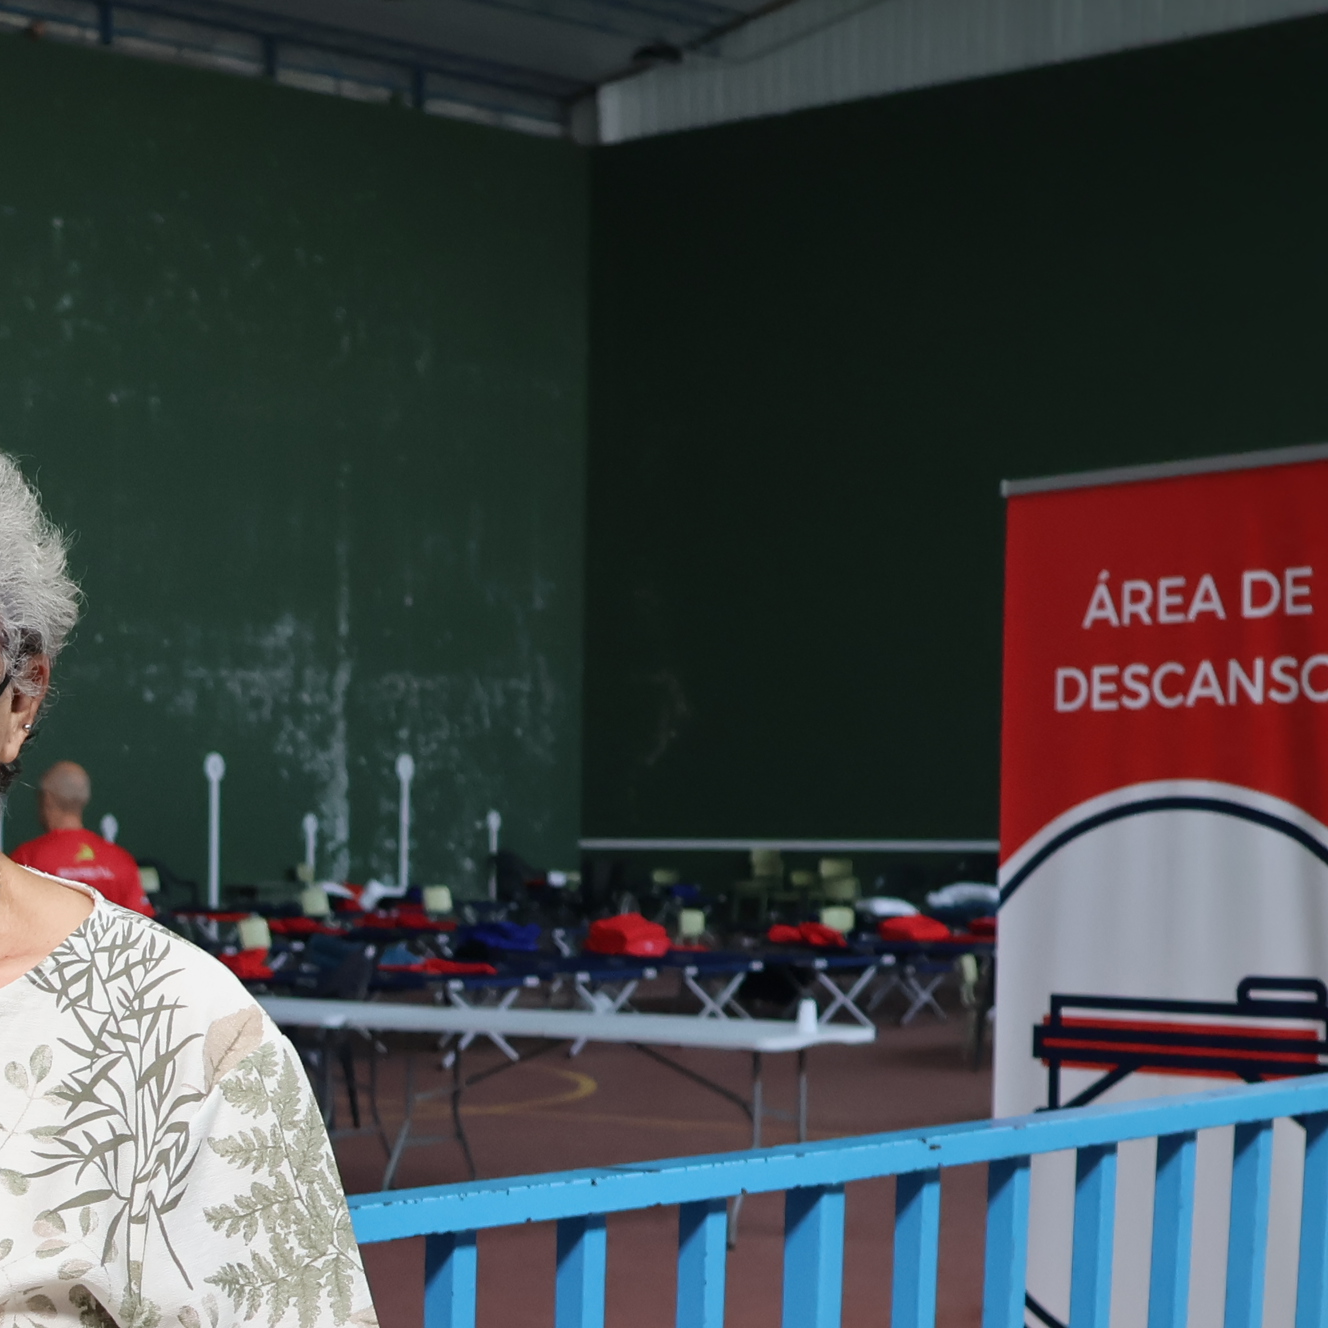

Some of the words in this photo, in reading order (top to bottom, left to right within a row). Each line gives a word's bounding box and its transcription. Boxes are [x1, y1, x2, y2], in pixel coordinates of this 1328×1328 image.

[1083, 569, 1226, 629] ÁREA
[1242, 566, 1313, 618] DE
[1055, 654, 1328, 712] DESCANSO
